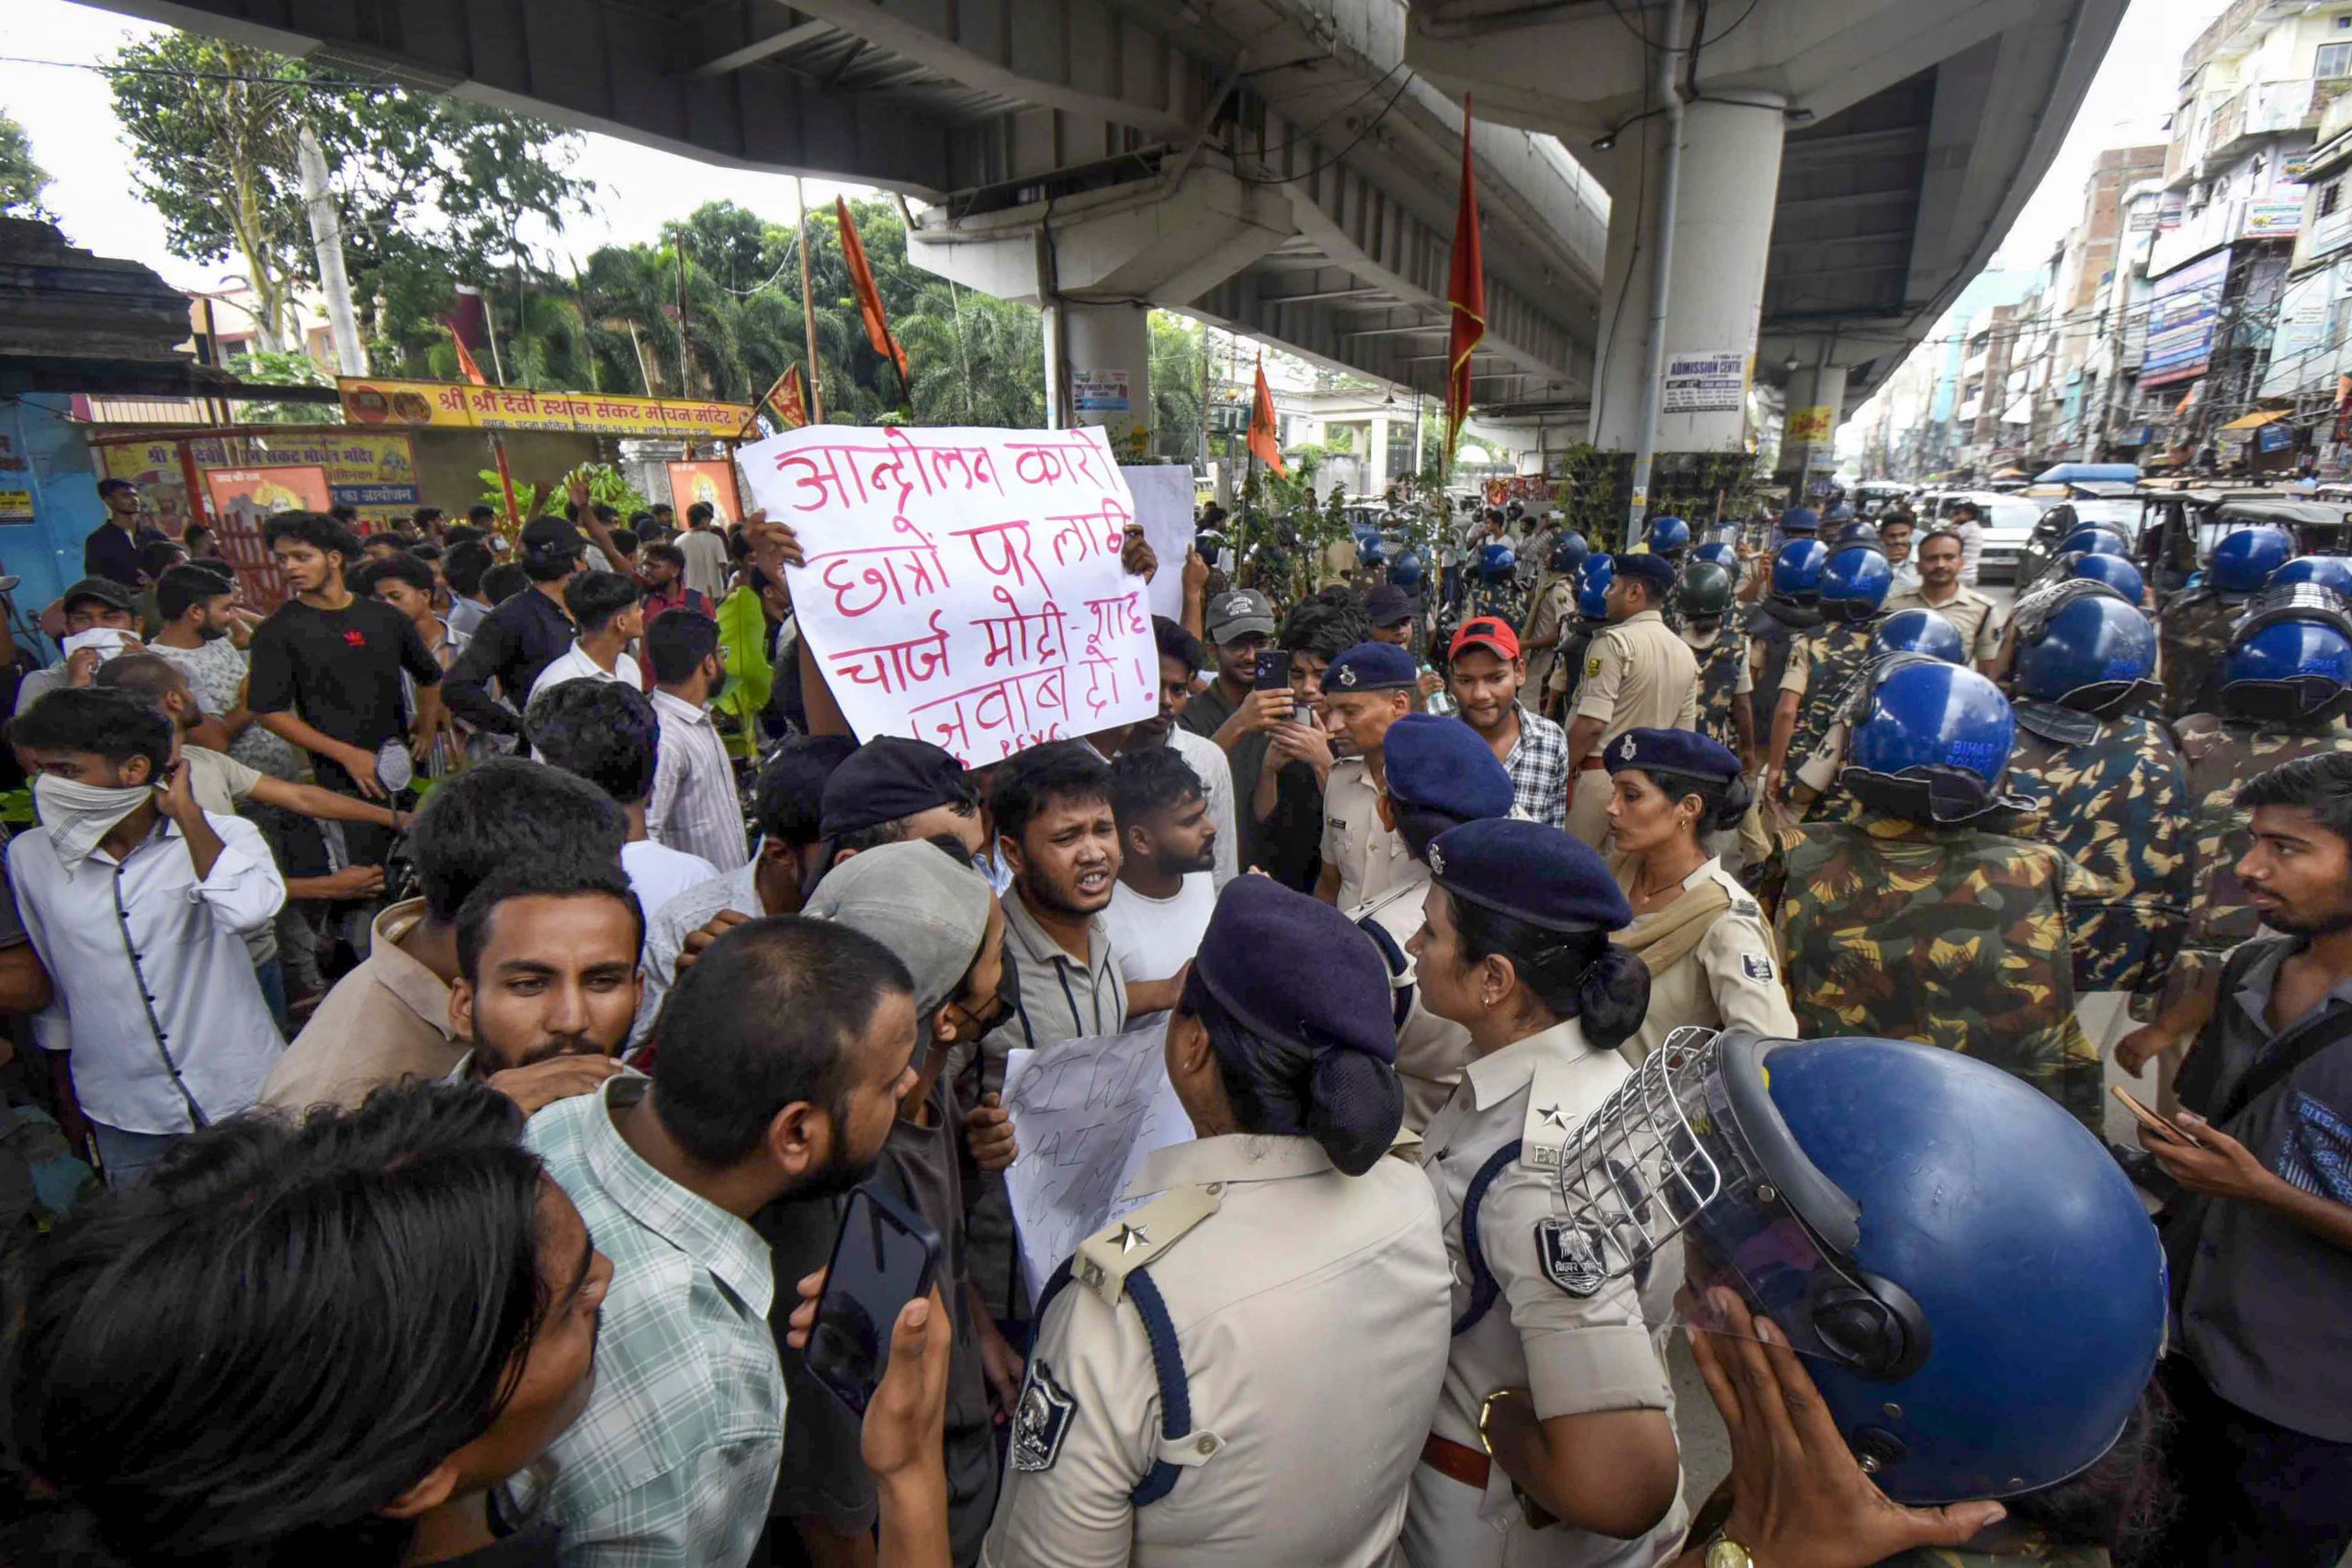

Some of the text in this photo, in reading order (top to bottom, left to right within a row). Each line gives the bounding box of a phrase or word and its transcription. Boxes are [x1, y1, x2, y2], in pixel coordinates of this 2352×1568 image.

[438, 386, 732, 425] श्री श्री देवी स्थान संकट मोचन मंदिर
[1670, 361, 1717, 375] ADMISSION
[948, 520, 1053, 600] पर
[828, 609, 950, 694] चार्ज
[908, 664, 1070, 750] जवाब
